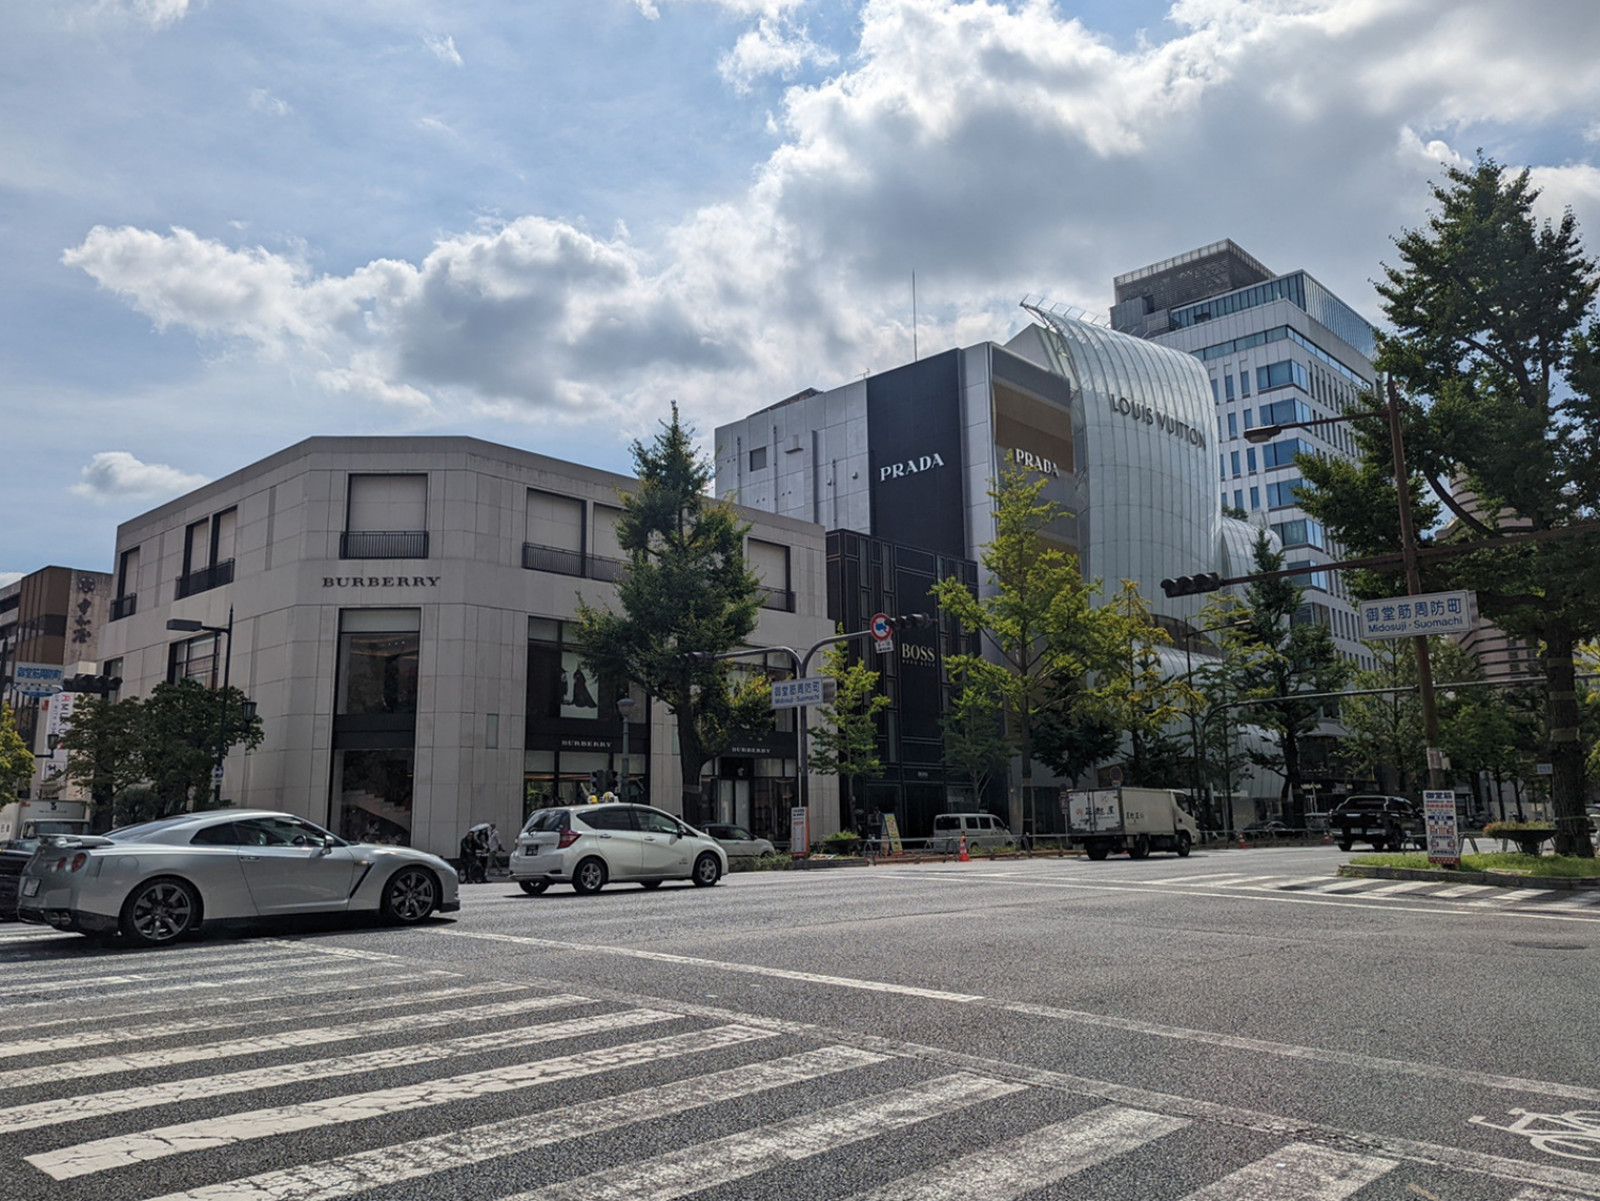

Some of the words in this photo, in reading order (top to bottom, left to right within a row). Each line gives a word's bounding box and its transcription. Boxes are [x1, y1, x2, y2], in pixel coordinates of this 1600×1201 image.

[1110, 394, 1153, 426] LOUIS
[1156, 411, 1206, 451] VUITTON
[879, 452, 944, 482] PRADA
[1015, 448, 1060, 477] PRADA
[322, 576, 441, 588] BURBERRY
[1366, 598, 1462, 622] 御堂筋周防町
[1368, 621, 1407, 633] Midosuji
[1414, 616, 1463, 629] Suomachi
[902, 643, 936, 662] BOSS
[561, 740, 612, 748] BURBERRY
